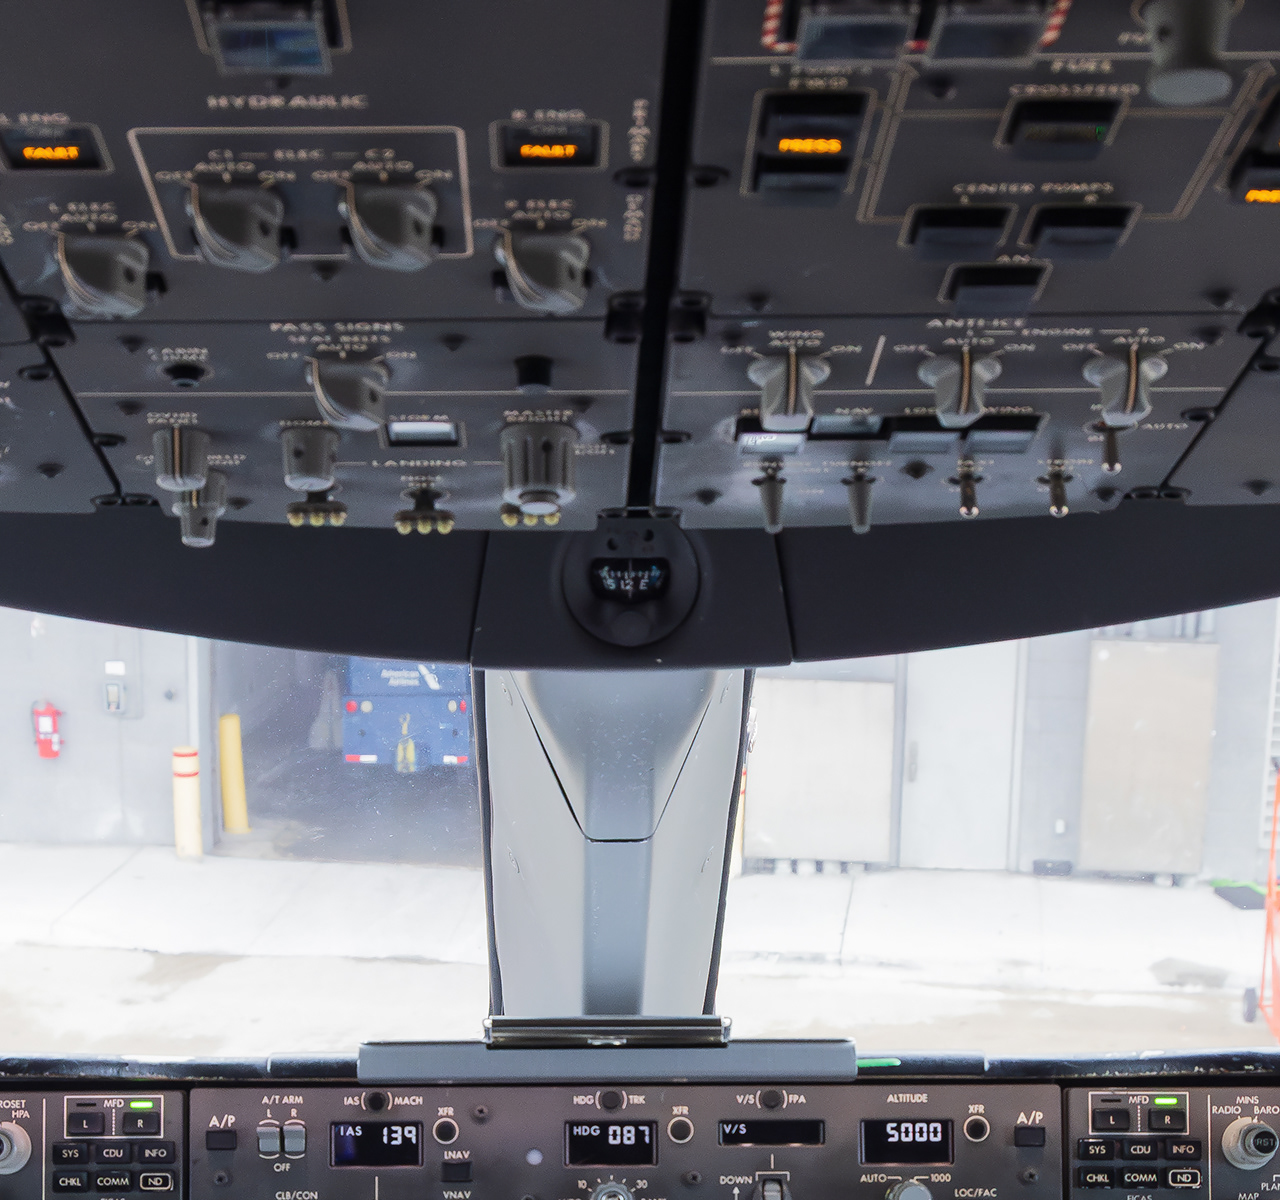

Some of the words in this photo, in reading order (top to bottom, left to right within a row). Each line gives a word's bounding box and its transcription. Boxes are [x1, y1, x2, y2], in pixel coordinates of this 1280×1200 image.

[207, 95, 364, 108] HYDRAULIC
[23, 146, 78, 159] FAULT
[520, 145, 577, 157] FAULT
[262, 1095, 280, 1104] A/T
[887, 1094, 927, 1103] ALTITUDE
[209, 1114, 235, 1128] A/P
[573, 1126, 600, 1136] HDG
[724, 1124, 746, 1134] V/S
[887, 1123, 941, 1142] 5000
[341, 1126, 362, 1136] IAS
[383, 1126, 416, 1145] 139
[608, 1126, 650, 1144] 087
[63, 1149, 78, 1157] SYS
[103, 1149, 123, 1157] CDU
[444, 1151, 470, 1159] LNAV
[59, 1178, 81, 1186] CHKL
[720, 1176, 753, 1184] DOWN
[931, 1173, 951, 1182] 1000
[276, 1191, 318, 1200] CLB/CON
[443, 1191, 471, 1199] VNAV
[955, 1188, 997, 1197] LOC/FAC
